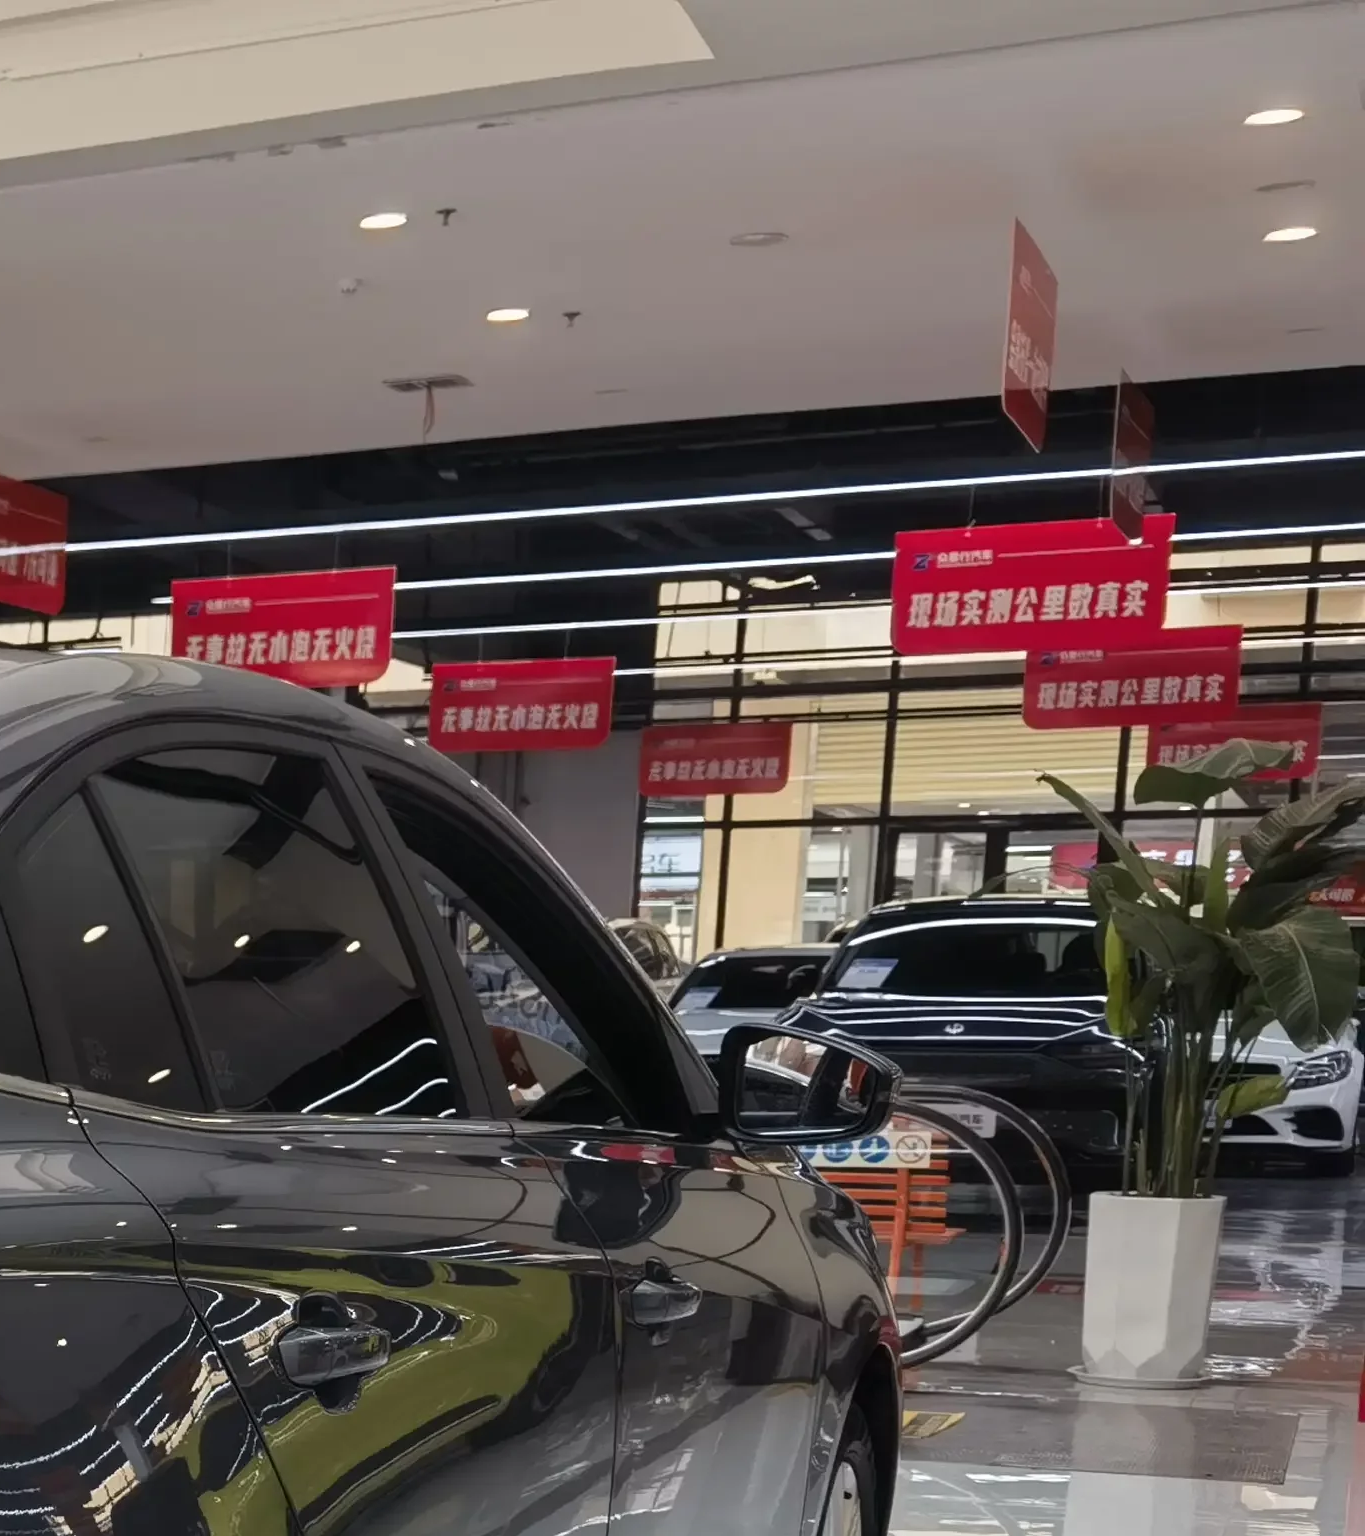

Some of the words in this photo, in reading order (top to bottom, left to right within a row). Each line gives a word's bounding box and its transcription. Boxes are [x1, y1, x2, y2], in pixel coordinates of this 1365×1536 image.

[906, 580, 1150, 629] 现场实测公里数真实
[186, 625, 377, 666] 无事故无水泡无火烧
[1037, 674, 1226, 709] 现场实测公里数真实
